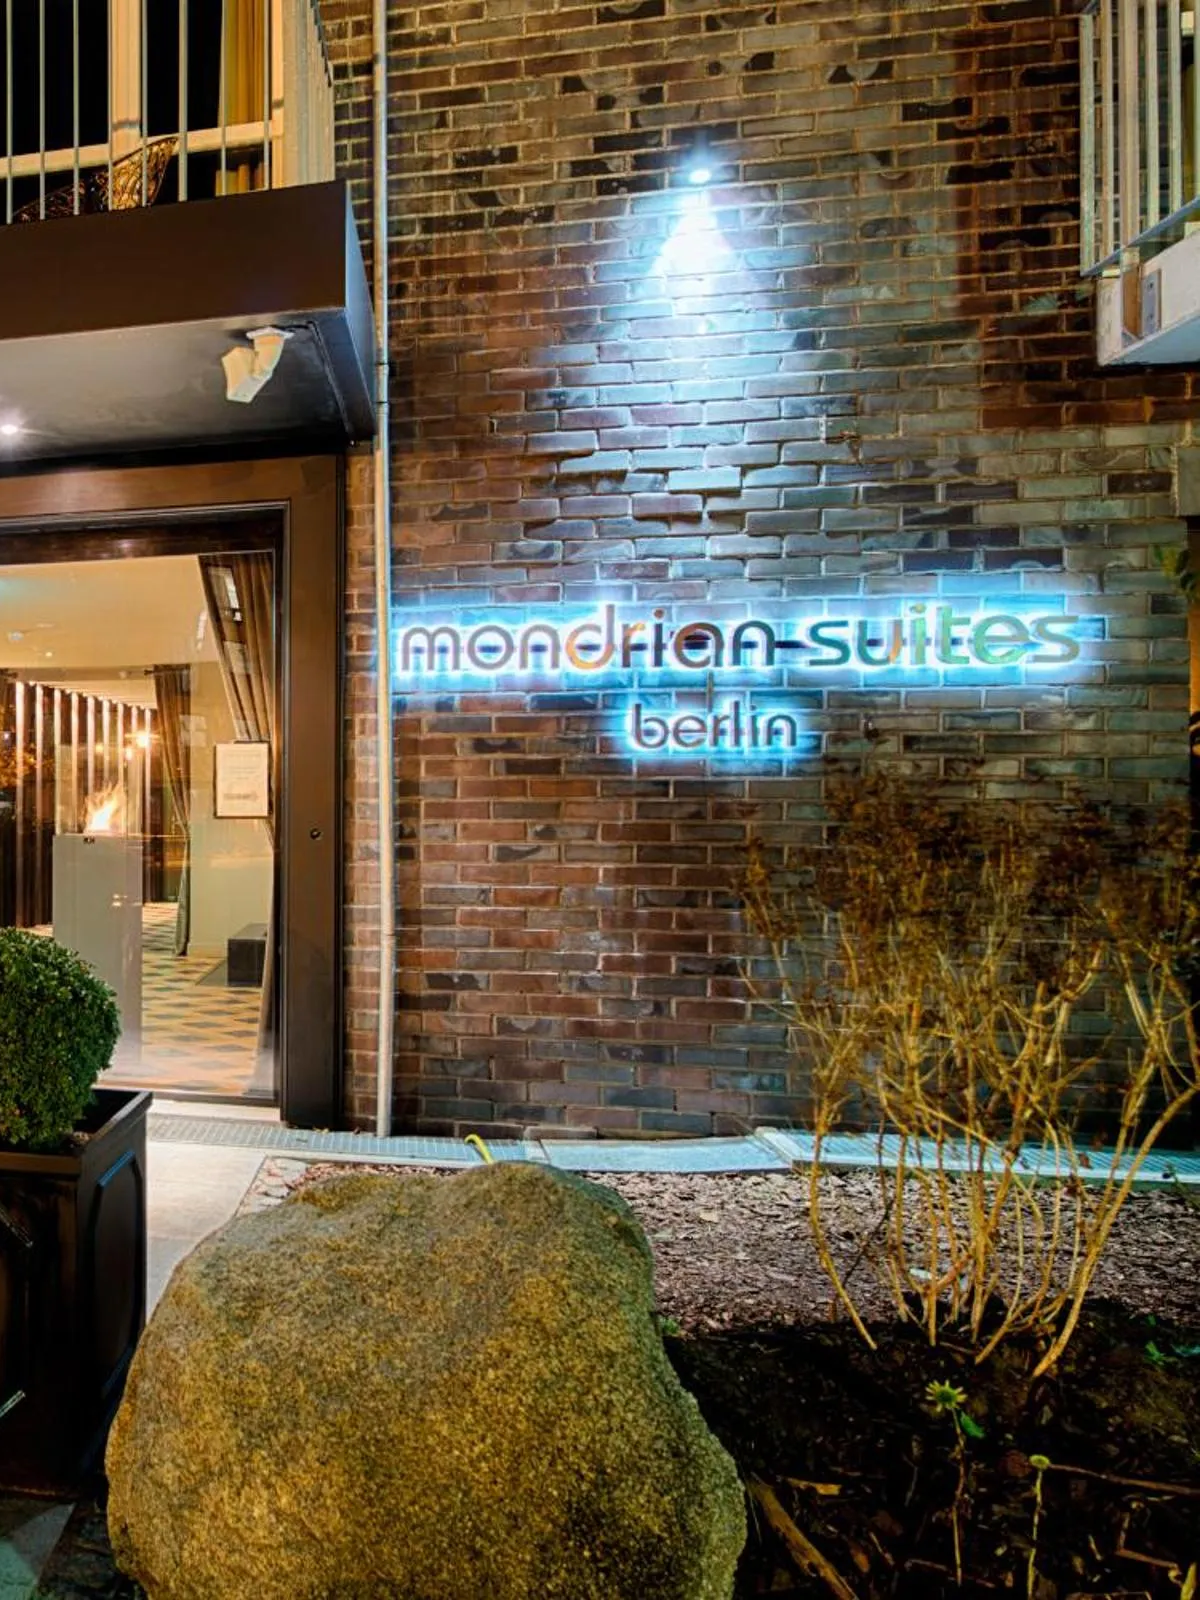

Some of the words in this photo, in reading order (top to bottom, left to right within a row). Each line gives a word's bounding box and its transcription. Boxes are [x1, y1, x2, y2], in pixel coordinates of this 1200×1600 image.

[401, 604, 776, 671] mondrian
[806, 602, 1082, 667] suites
[630, 700, 798, 749] berlin
